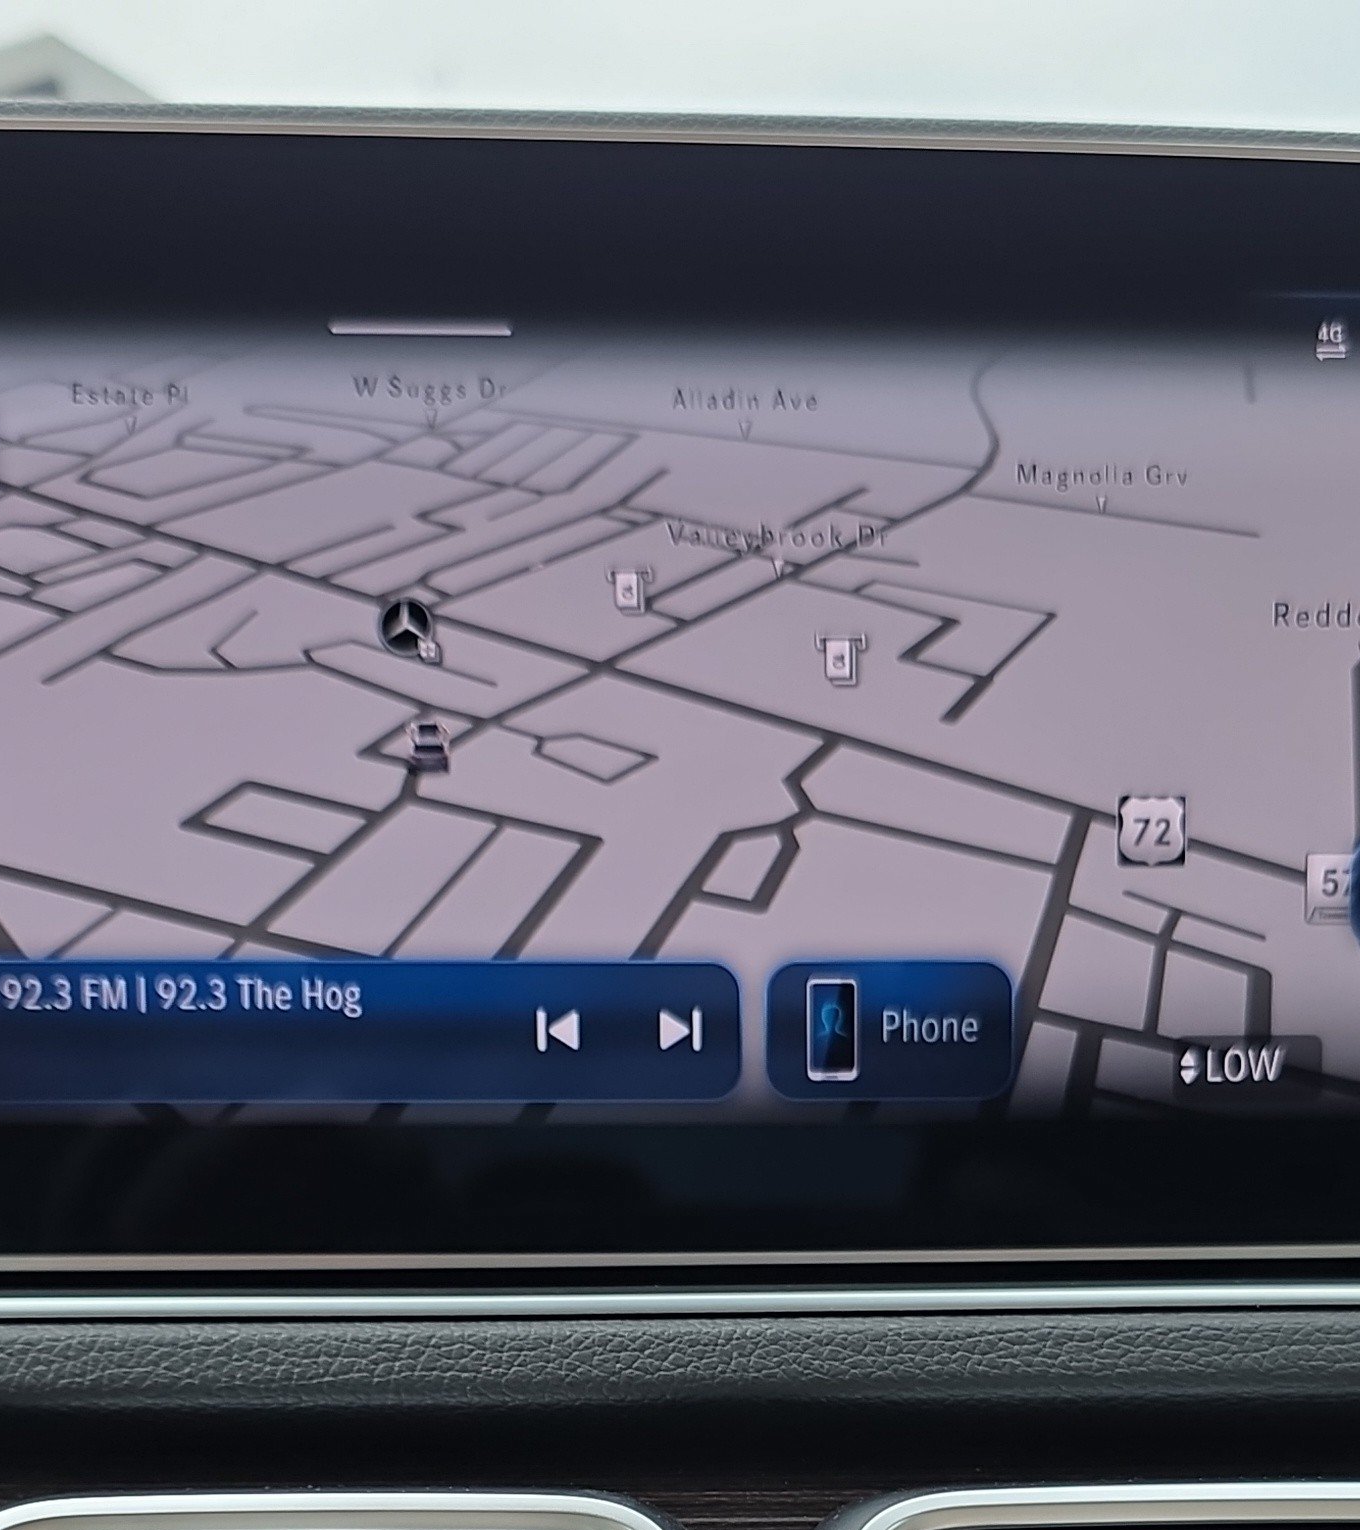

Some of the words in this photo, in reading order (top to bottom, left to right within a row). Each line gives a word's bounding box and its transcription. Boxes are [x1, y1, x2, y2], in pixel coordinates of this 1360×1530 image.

[72, 382, 154, 406] Estate
[353, 374, 381, 397] W
[388, 375, 468, 406] Suggs
[479, 376, 508, 399] Dr
[773, 387, 819, 412] Ave
[1016, 463, 1134, 493] Magnolia
[1145, 464, 1188, 487] Grv
[665, 520, 844, 552] Valleybrook
[857, 523, 888, 548] Dr
[1132, 817, 1172, 848] 72
[82, 978, 129, 1012] FM
[155, 978, 228, 1012] 92.3
[236, 978, 293, 1012] The
[301, 979, 363, 1018] Hog
[880, 1009, 980, 1044] Phone
[1205, 1046, 1285, 1083] LOW
